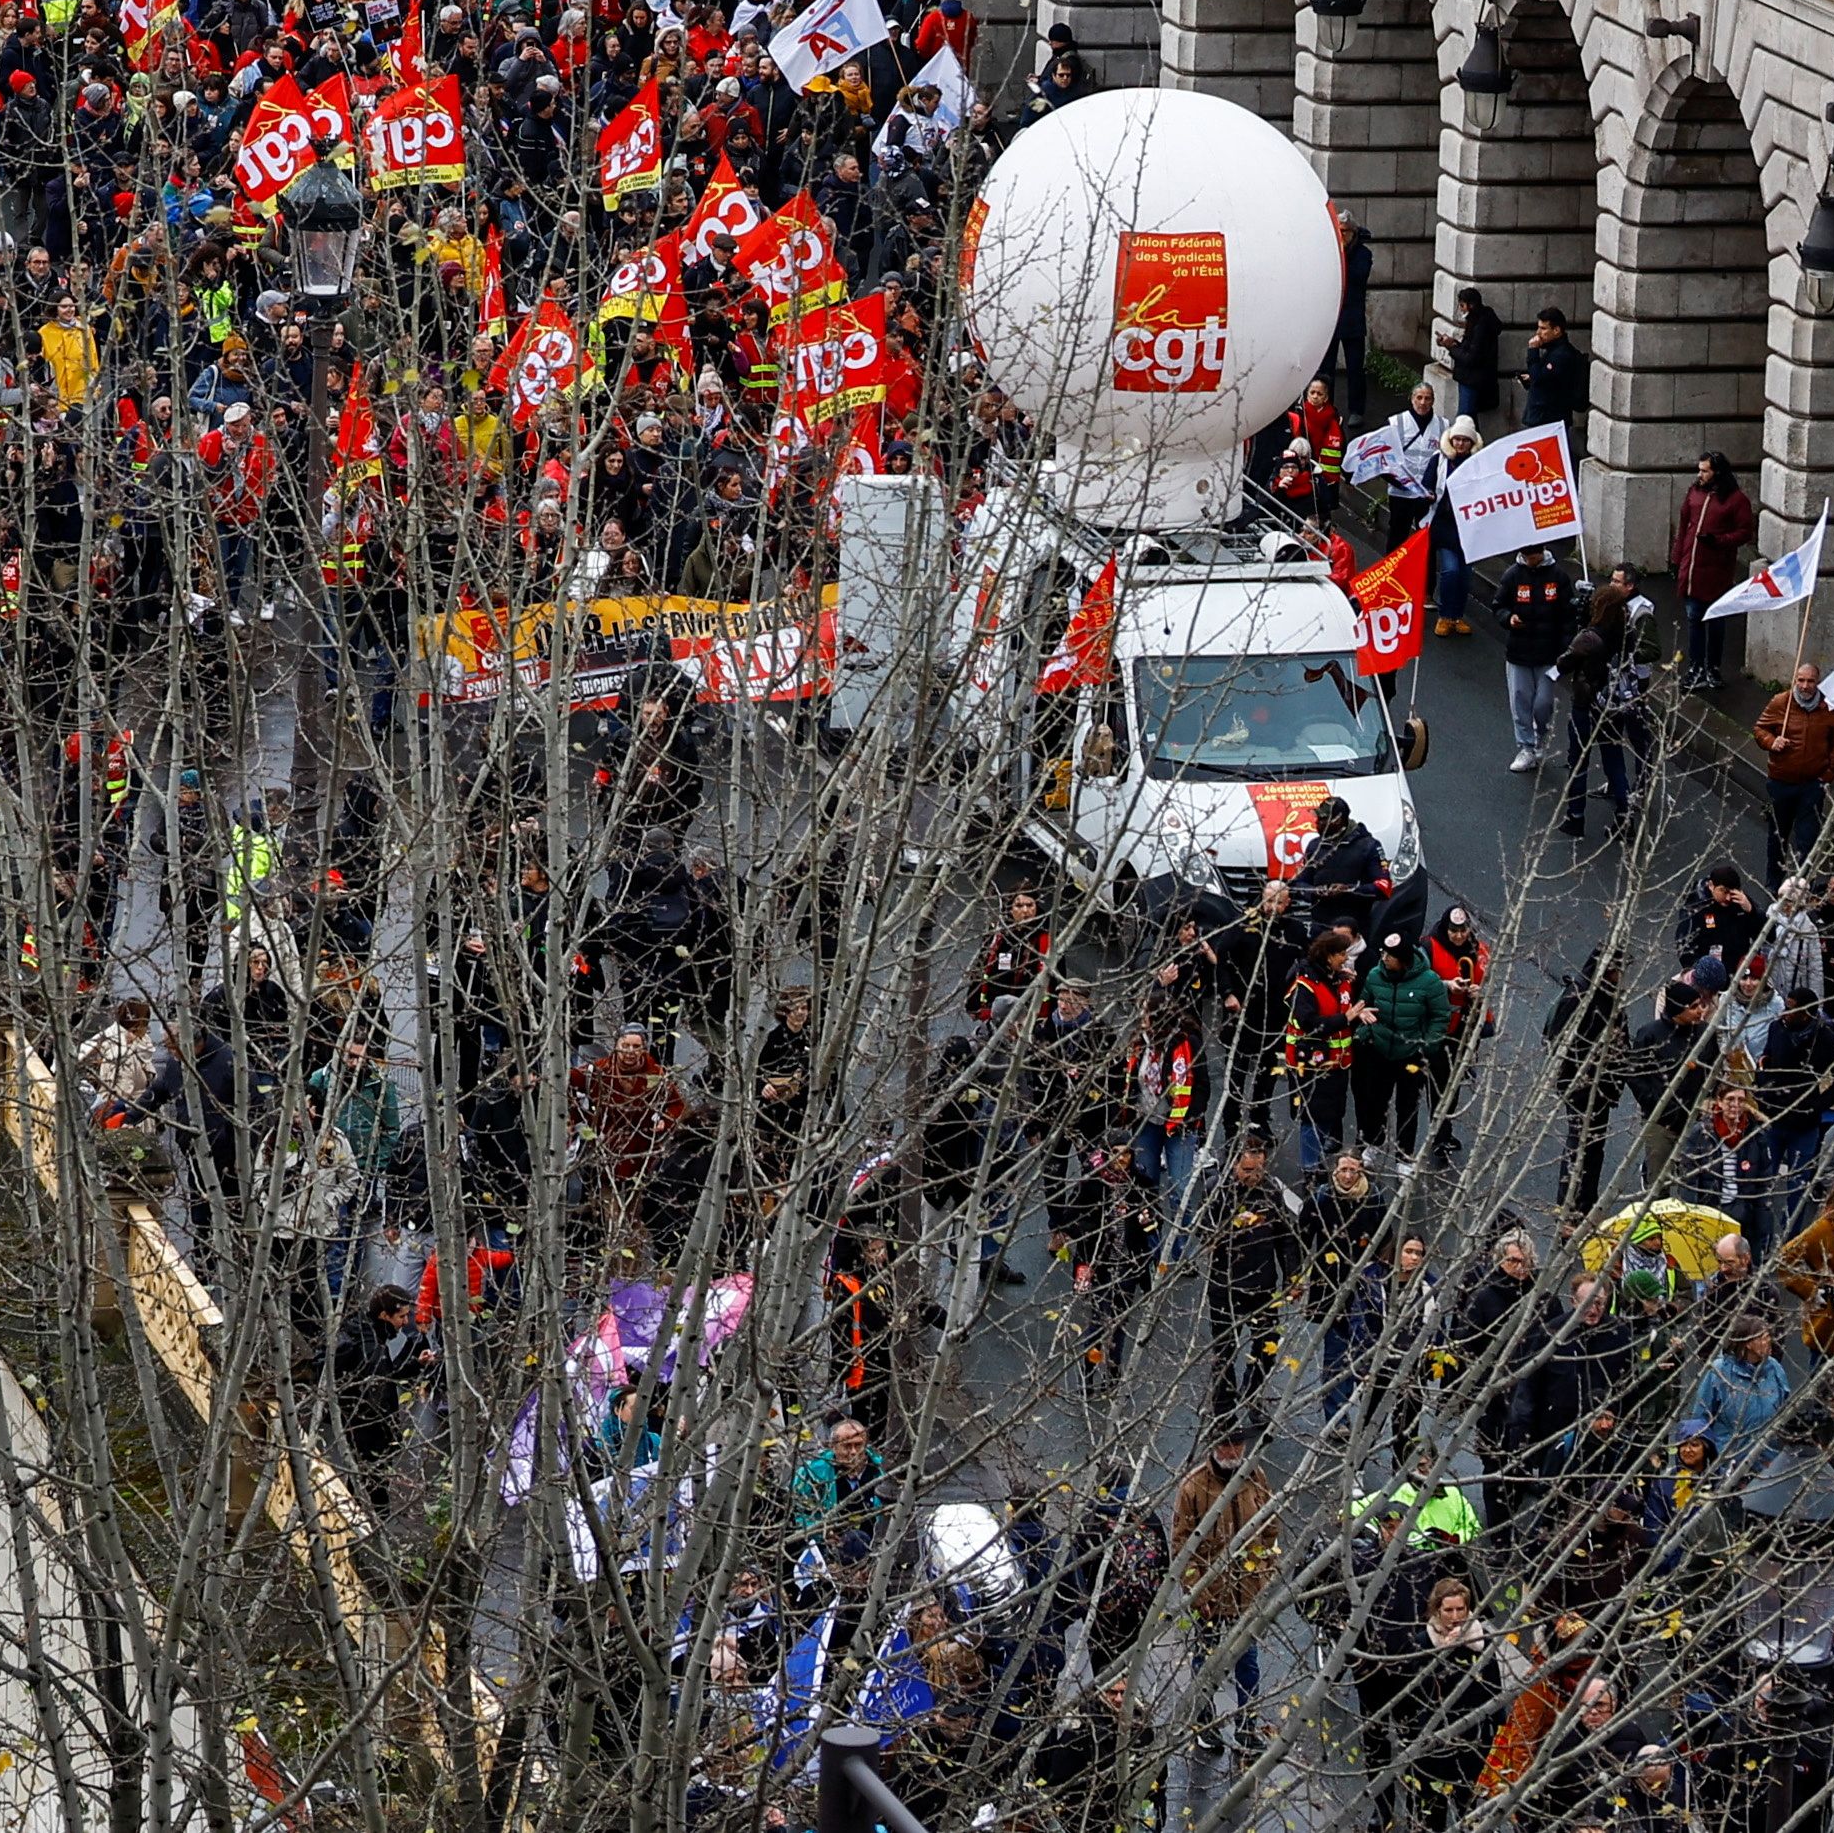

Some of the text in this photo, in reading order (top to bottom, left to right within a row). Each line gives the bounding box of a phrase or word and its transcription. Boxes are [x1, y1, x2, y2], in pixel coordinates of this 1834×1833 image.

[1131, 236, 1223, 248] Union Fédérale
[1135, 251, 1224, 265] des Syndicats
[1172, 263, 1225, 277] de l'État
[1131, 283, 1222, 327] la
[1113, 315, 1228, 384] cgt
[1517, 589, 1531, 599] cgt
[1544, 586, 1557, 597] cgt
[715, 626, 803, 681] STOP
[1264, 785, 1328, 794] fédération
